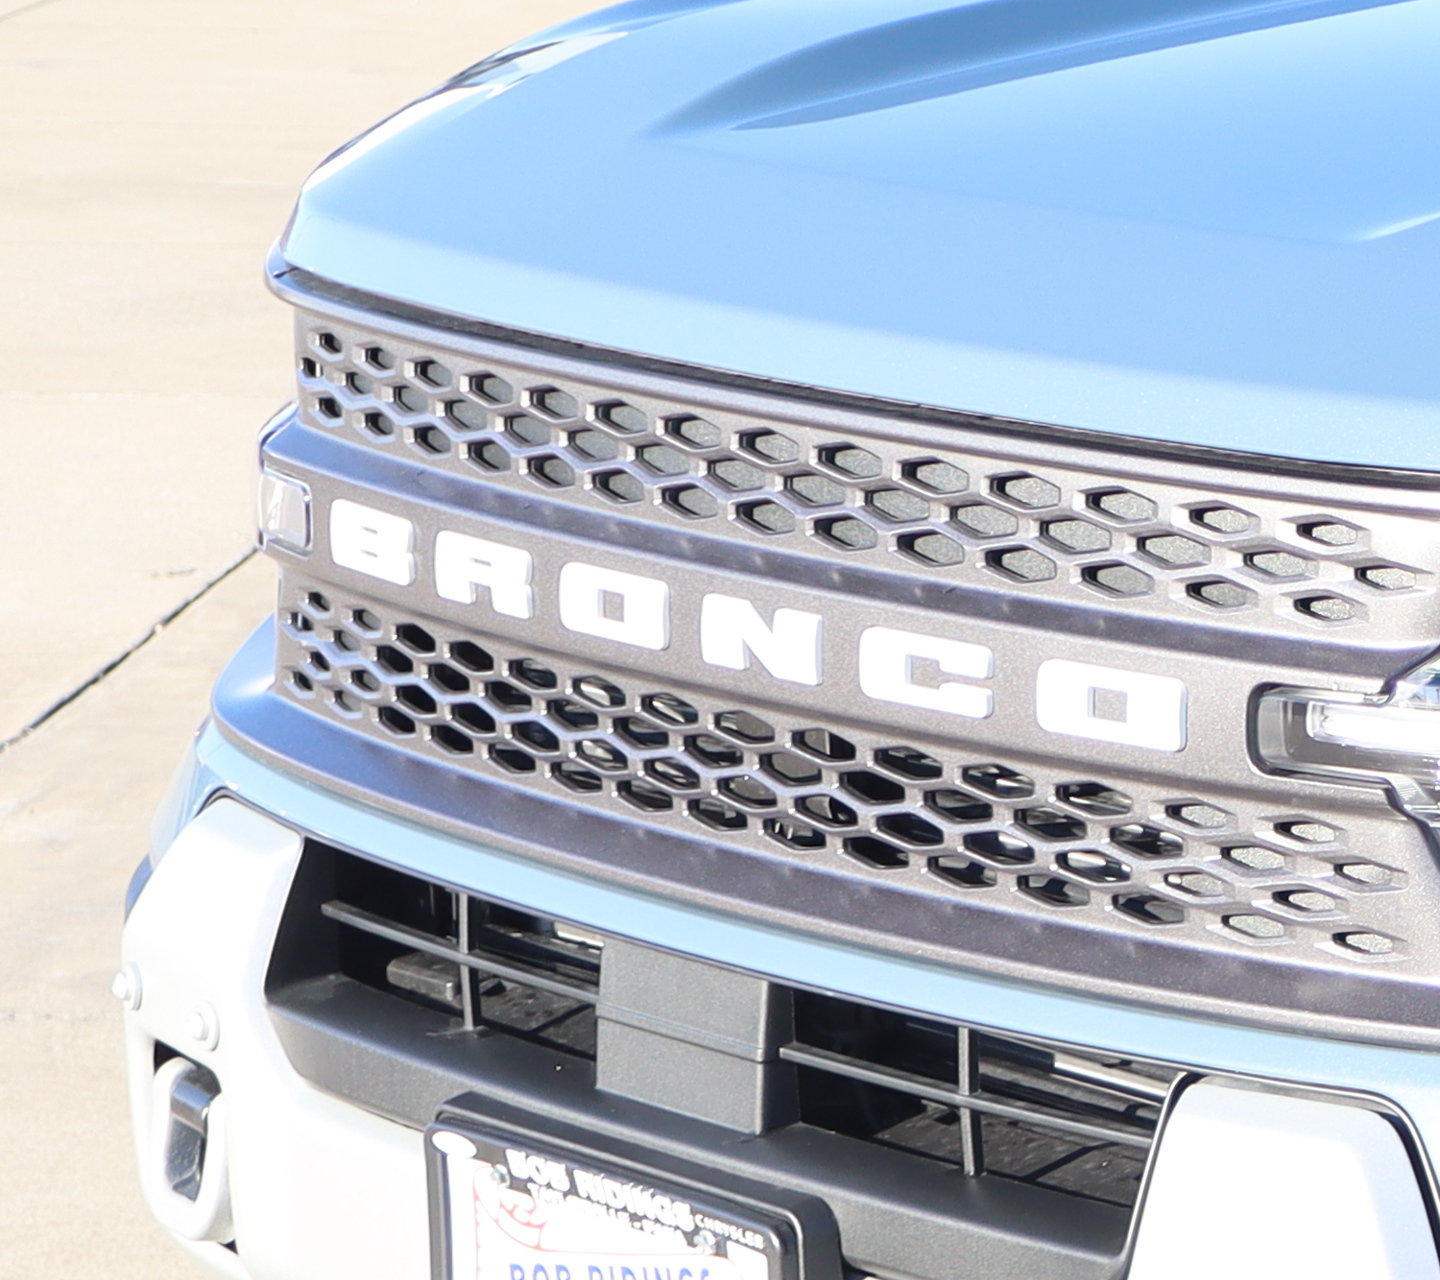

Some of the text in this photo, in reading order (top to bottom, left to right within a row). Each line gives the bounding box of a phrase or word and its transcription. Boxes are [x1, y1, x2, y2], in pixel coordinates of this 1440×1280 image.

[329, 498, 1189, 753] BRONCO
[504, 1148, 571, 1192] BOB
[572, 1169, 696, 1232] RIDINGS
